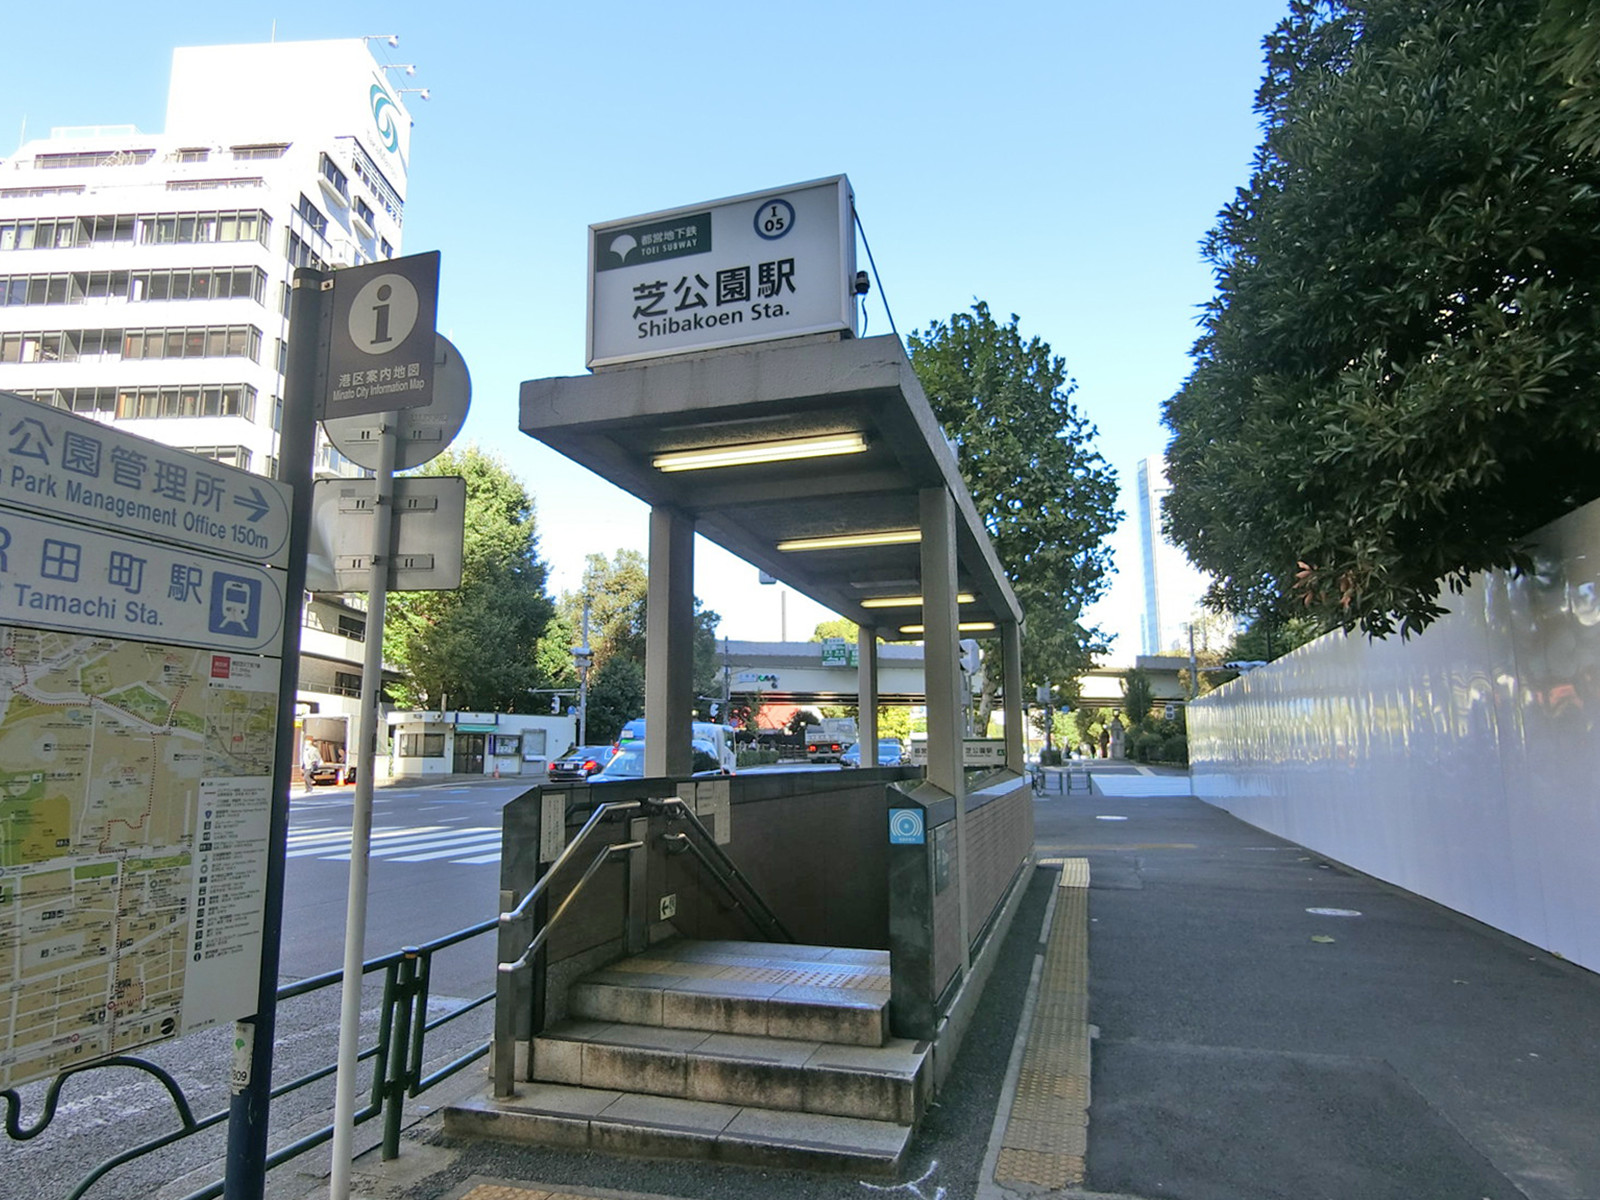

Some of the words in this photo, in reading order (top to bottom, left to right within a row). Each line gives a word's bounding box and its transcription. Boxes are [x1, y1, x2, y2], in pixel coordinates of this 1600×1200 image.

[764, 217, 784, 232] 05
[770, 206, 778, 218] I
[641, 225, 698, 246] 都営地下鉄
[641, 245, 660, 256] TOEI
[662, 238, 698, 252] SUBWAY
[632, 257, 796, 319] 芝公園駅
[638, 309, 743, 339] Shibakoen
[751, 302, 790, 321] Sta.
[338, 362, 420, 388] 港区案内地図
[332, 390, 355, 401] Minato
[356, 385, 370, 399] City
[370, 381, 409, 396] Information
[409, 378, 425, 391] Map
[8, 416, 226, 512] 公園管理所
[10, 465, 57, 498] Park
[65, 479, 177, 527] Management
[183, 511, 227, 539] Office
[231, 523, 268, 549] 150m
[14, 582, 117, 619] Tamachi
[124, 600, 164, 626] Sta.
